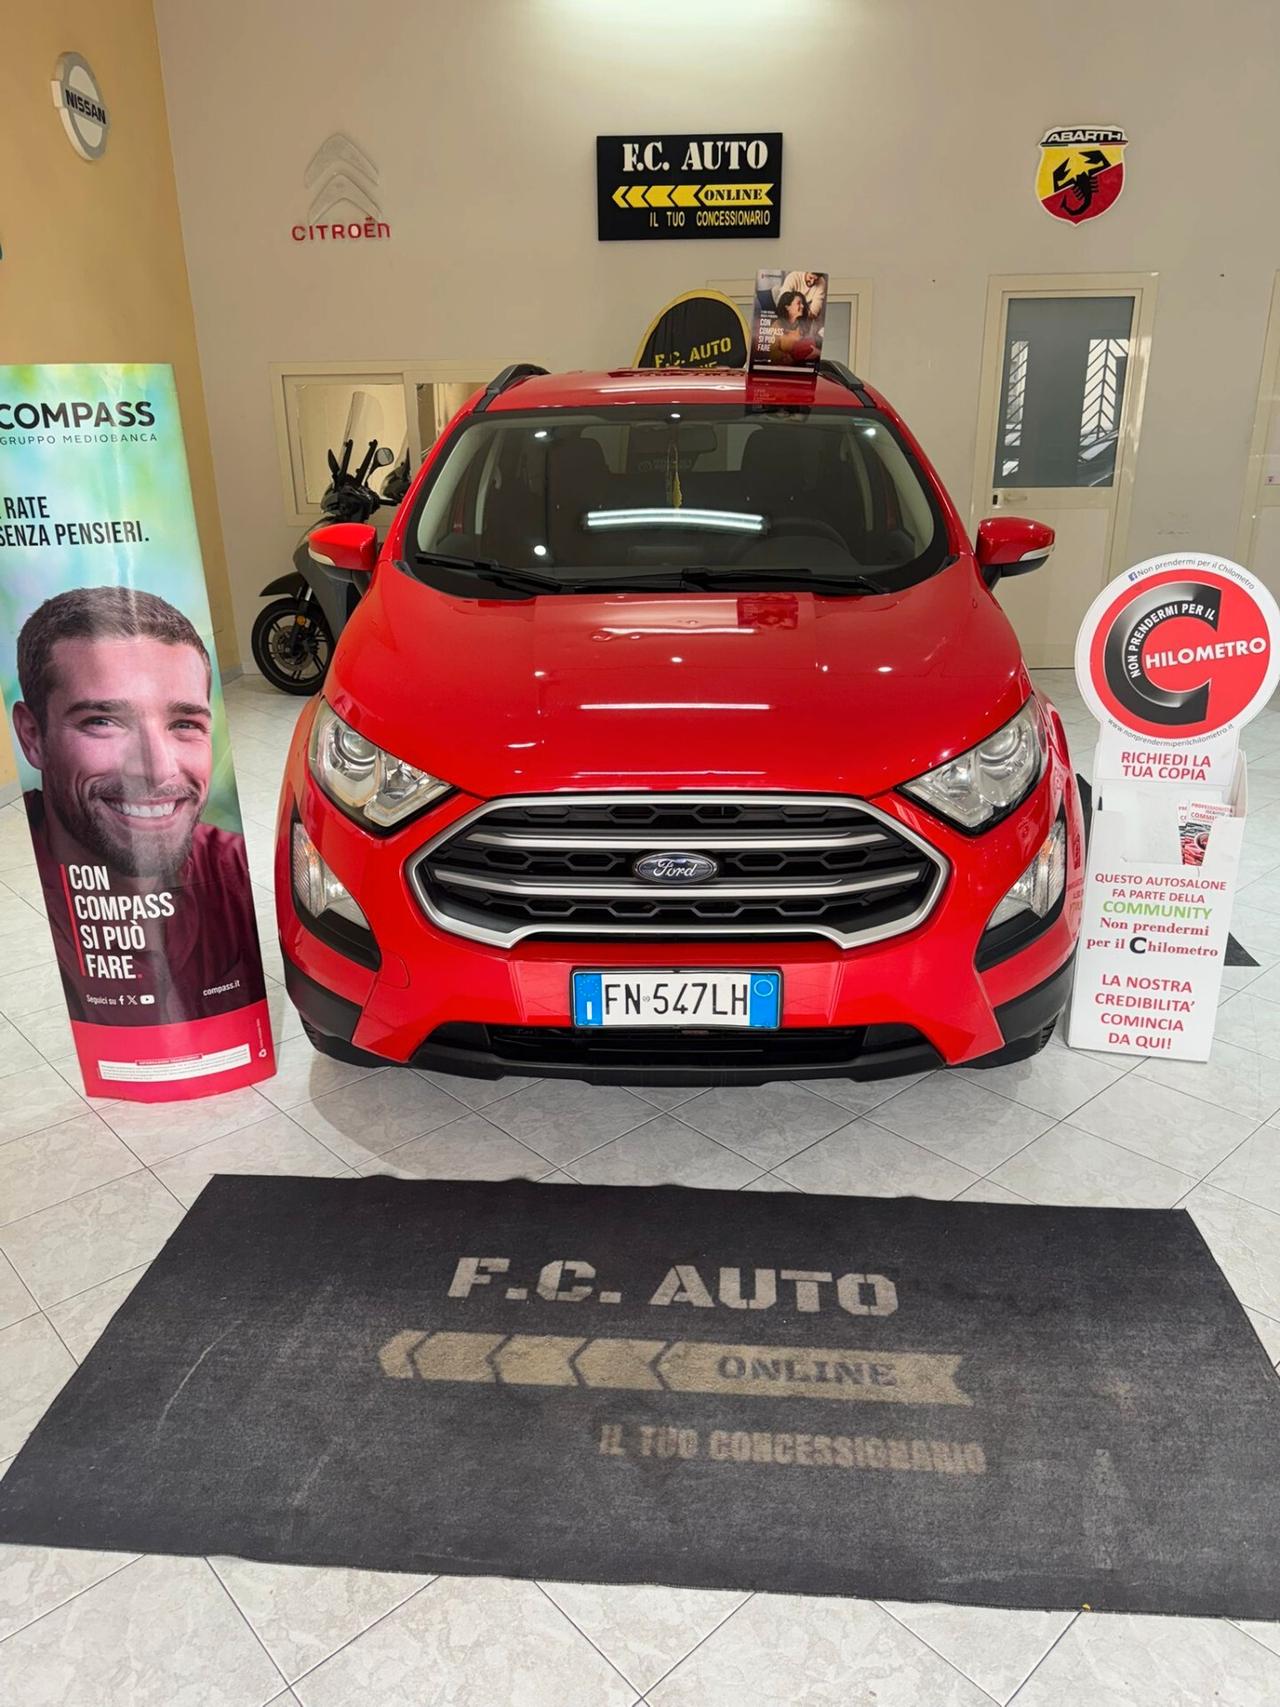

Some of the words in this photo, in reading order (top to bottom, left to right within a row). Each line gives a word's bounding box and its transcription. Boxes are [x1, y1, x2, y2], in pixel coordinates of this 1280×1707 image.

[65, 90, 106, 124] NISSAN
[1047, 130, 1121, 142] ABARTH
[622, 141, 670, 171] F.C.
[681, 140, 768, 170] AUTO
[704, 188, 763, 201] ONLINE
[650, 212, 659, 227] IL
[666, 211, 685, 227] TUO
[696, 209, 770, 226] CONCESSIONARIO
[689, 337, 732, 362] AUTO
[0, 435, 56, 445] GRUPPO
[63, 433, 158, 444] MEDIOBANCA
[3, 496, 50, 519] RATE
[55, 520, 150, 545] PENSIERI.
[1137, 567, 1153, 577] Non
[1155, 558, 1195, 570] prendermi
[1197, 559, 1211, 567] per
[1212, 560, 1218, 569] il
[1218, 563, 1255, 590] Chilometro
[1181, 603, 1204, 615] PER
[1204, 608, 1215, 621] IL
[1128, 604, 1178, 651] PRENDERMI
[1127, 655, 1141, 678] NON
[1121, 751, 1188, 766] RICHIEDI
[1193, 755, 1211, 768] LA
[1122, 765, 1153, 778] TUA
[1158, 767, 1206, 781] COPIA
[68, 864, 111, 890] CON
[653, 858, 698, 877] Ford
[1095, 873, 1143, 885] QUESTO
[1146, 876, 1227, 890] AUTOSALONE
[1112, 888, 1126, 898] FA
[1129, 889, 1166, 901] PARTE
[1169, 892, 1205, 904] DELLA
[74, 892, 175, 920] COMPASS
[1103, 900, 1213, 920] COMMUNITY
[80, 924, 100, 950] SI
[102, 920, 146, 950] PUÒ
[1100, 917, 1128, 929] Non
[1133, 922, 1209, 936] prendermi
[1086, 938, 1111, 949] per
[1115, 938, 1125, 949] il
[203, 979, 241, 997] compass.it
[1102, 974, 1120, 987] LA
[1126, 976, 1192, 993] NOSTRA
[1100, 1012, 1184, 1032] COMINCIA
[1108, 1032, 1130, 1046] DA
[1135, 1035, 1172, 1050] QUI!
[447, 1257, 622, 1304] F.C.
[649, 1264, 899, 1317] AUTO
[716, 1355, 898, 1387] ONLINE
[599, 1423, 625, 1457] IL
[639, 1424, 698, 1460] TUO
[710, 1428, 987, 1476] CONCESSIONARIO
